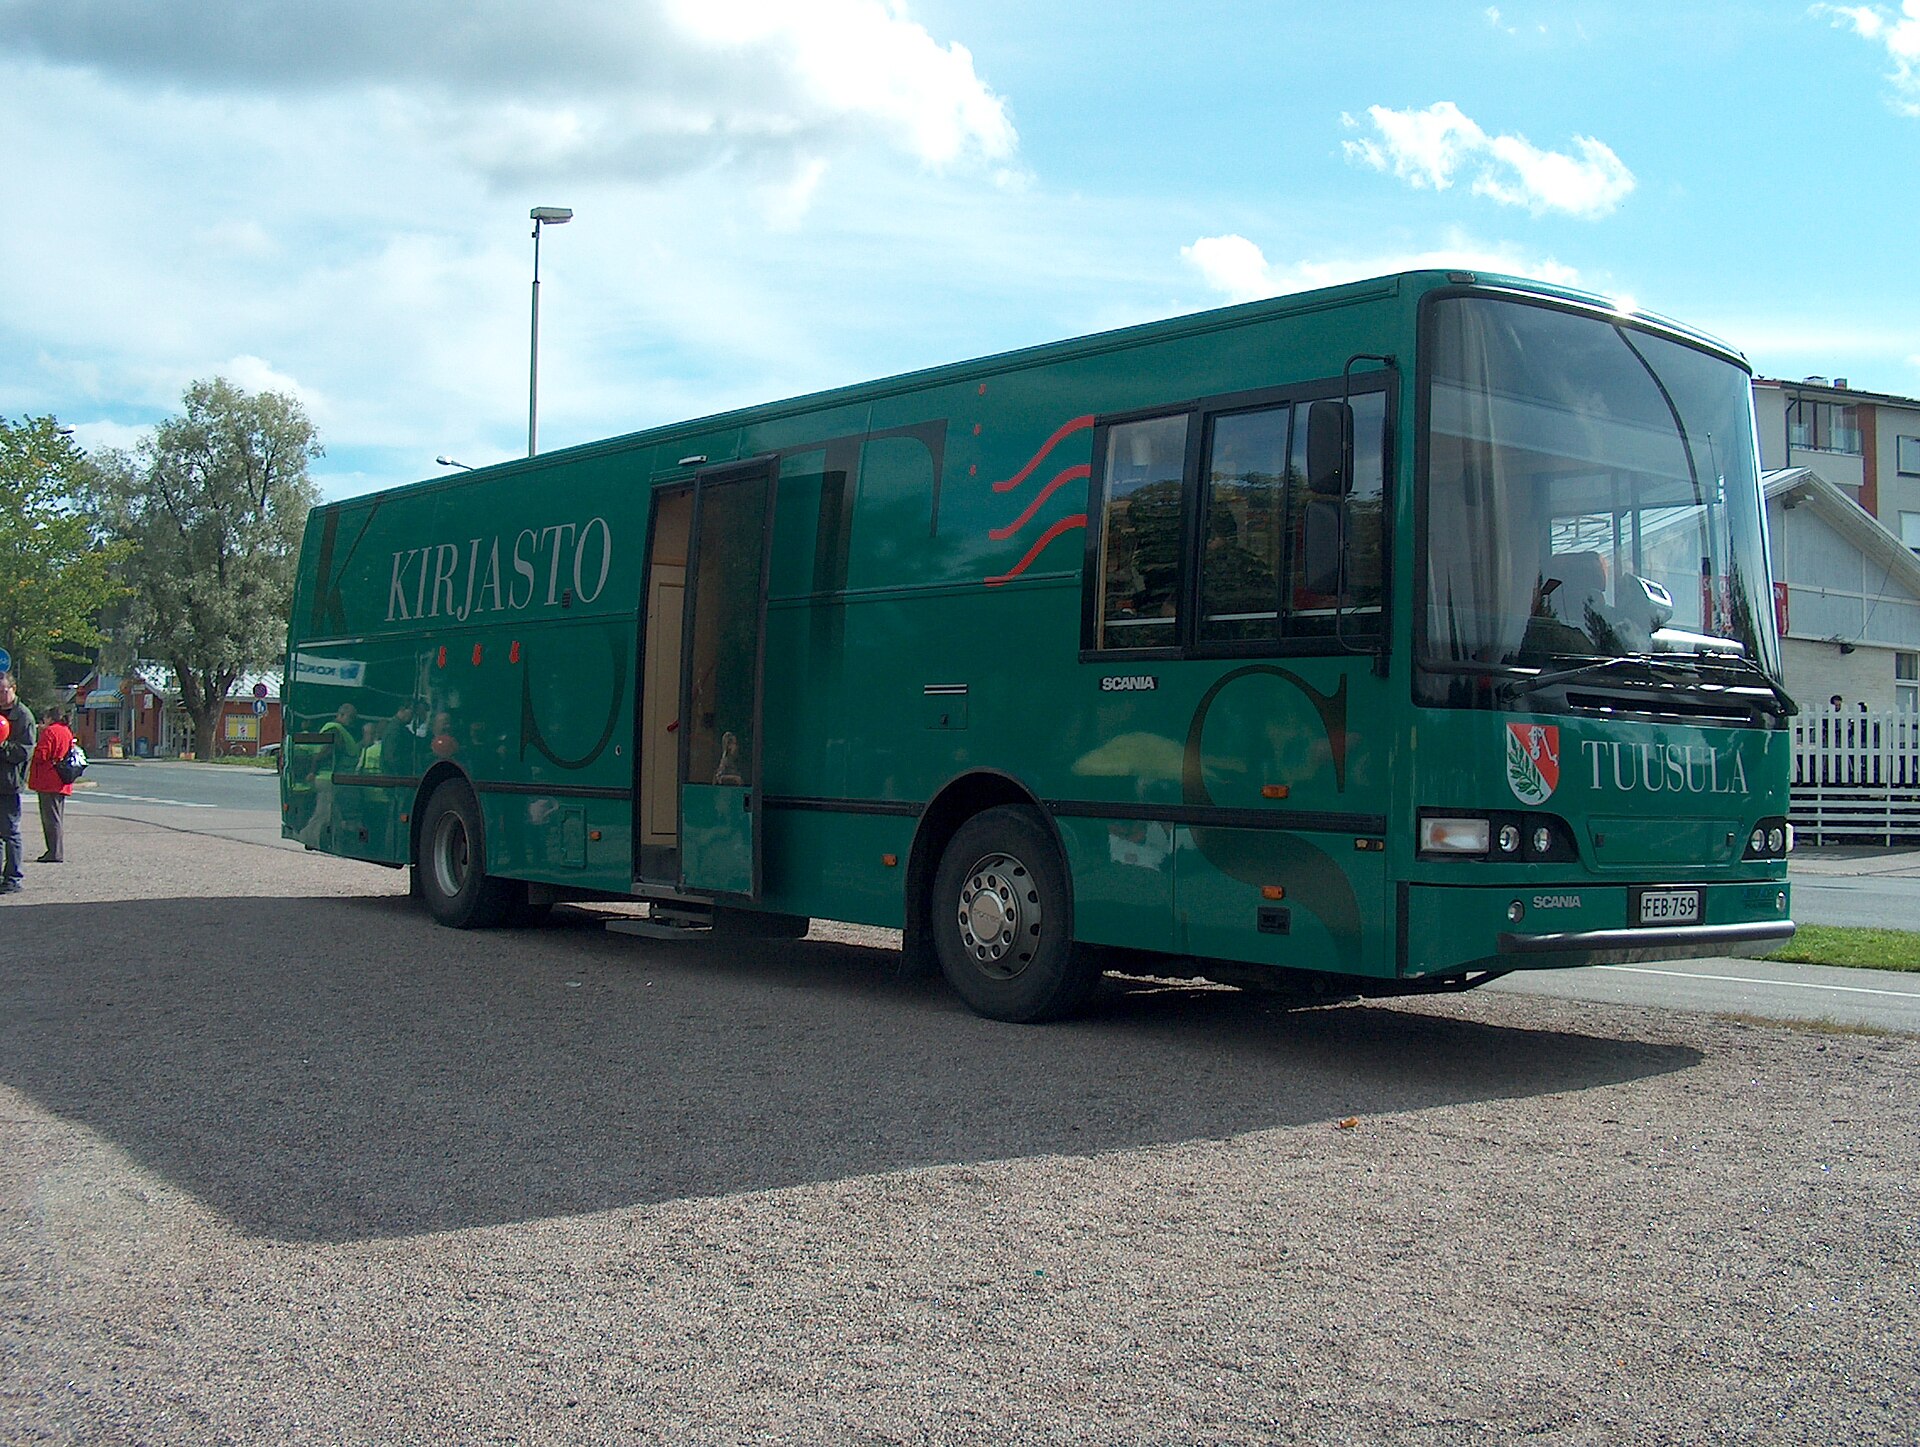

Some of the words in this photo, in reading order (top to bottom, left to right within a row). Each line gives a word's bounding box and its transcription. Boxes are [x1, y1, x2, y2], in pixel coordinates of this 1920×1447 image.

[384, 517, 611, 622] KIRJASTO
[1102, 676, 1155, 691] SCANIA
[1581, 740, 1749, 794] TUUSULA
[1533, 895, 1581, 909] SCANIA
[1643, 897, 1696, 918] FEB-759
